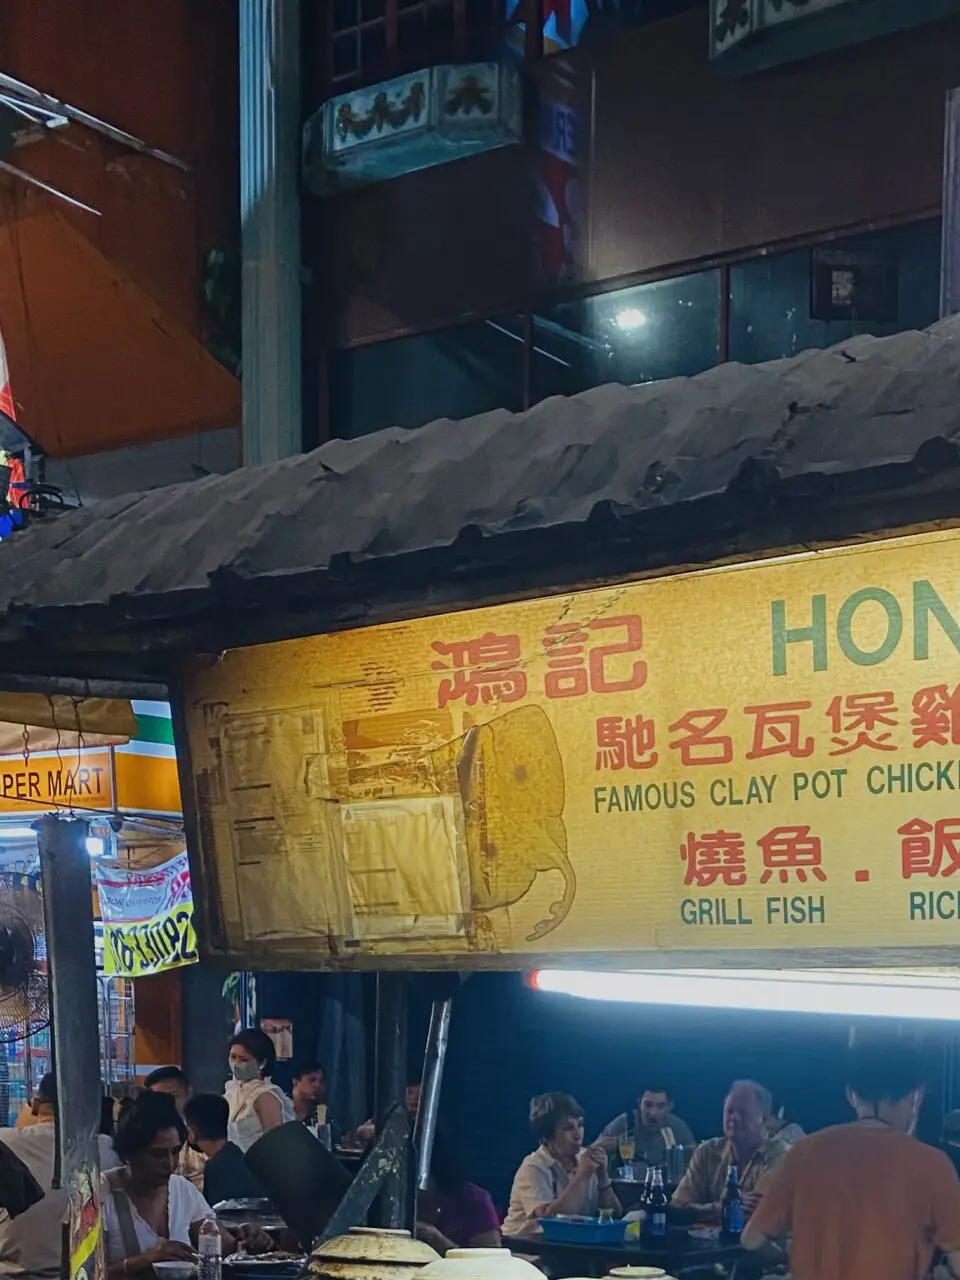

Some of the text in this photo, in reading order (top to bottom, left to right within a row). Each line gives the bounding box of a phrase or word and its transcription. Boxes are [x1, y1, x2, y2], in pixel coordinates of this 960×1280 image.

[431, 614, 648, 709] 鴻記
[2, 767, 104, 798] PER MART
[593, 780, 696, 813] FAMOUS
[709, 774, 778, 806] CLAY
[793, 768, 848, 801] POT
[680, 825, 828, 887] 燒魚
[680, 897, 753, 925] GRILL
[766, 895, 826, 924] FISH
